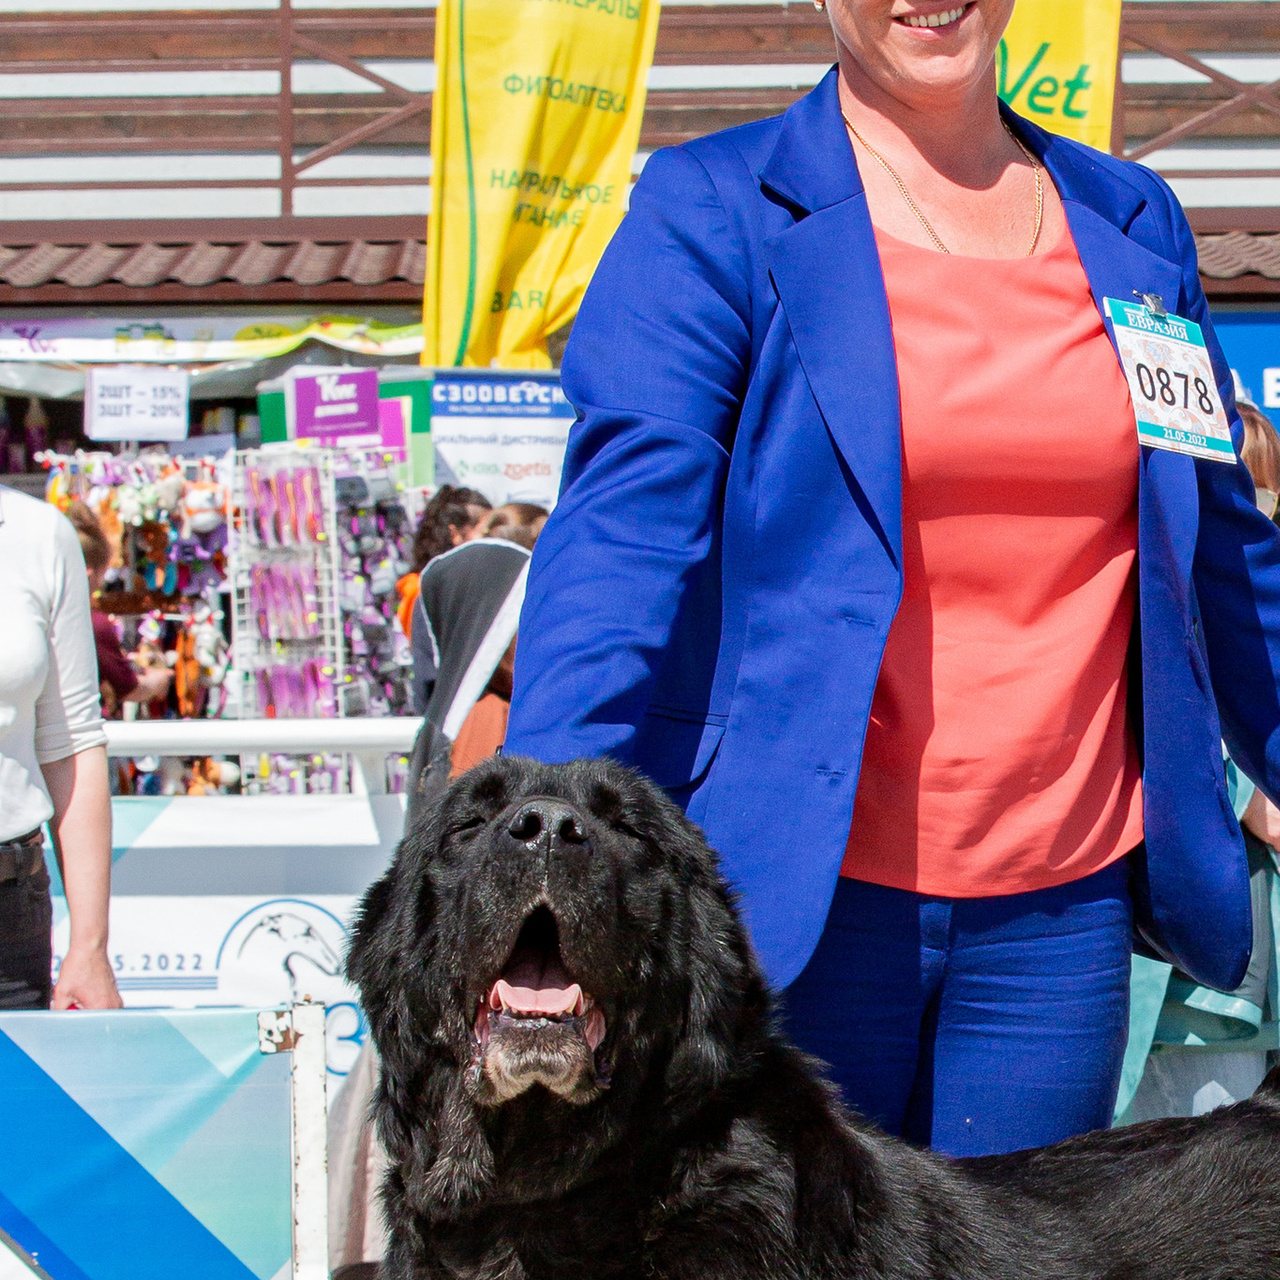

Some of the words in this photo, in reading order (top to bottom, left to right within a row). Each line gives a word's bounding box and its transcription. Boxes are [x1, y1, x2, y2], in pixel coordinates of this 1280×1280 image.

[1126, 312, 1190, 341] ЕВРАЗИЯ
[1135, 362, 1214, 416] 0878
[1162, 427, 1208, 448] 21.05.2022
